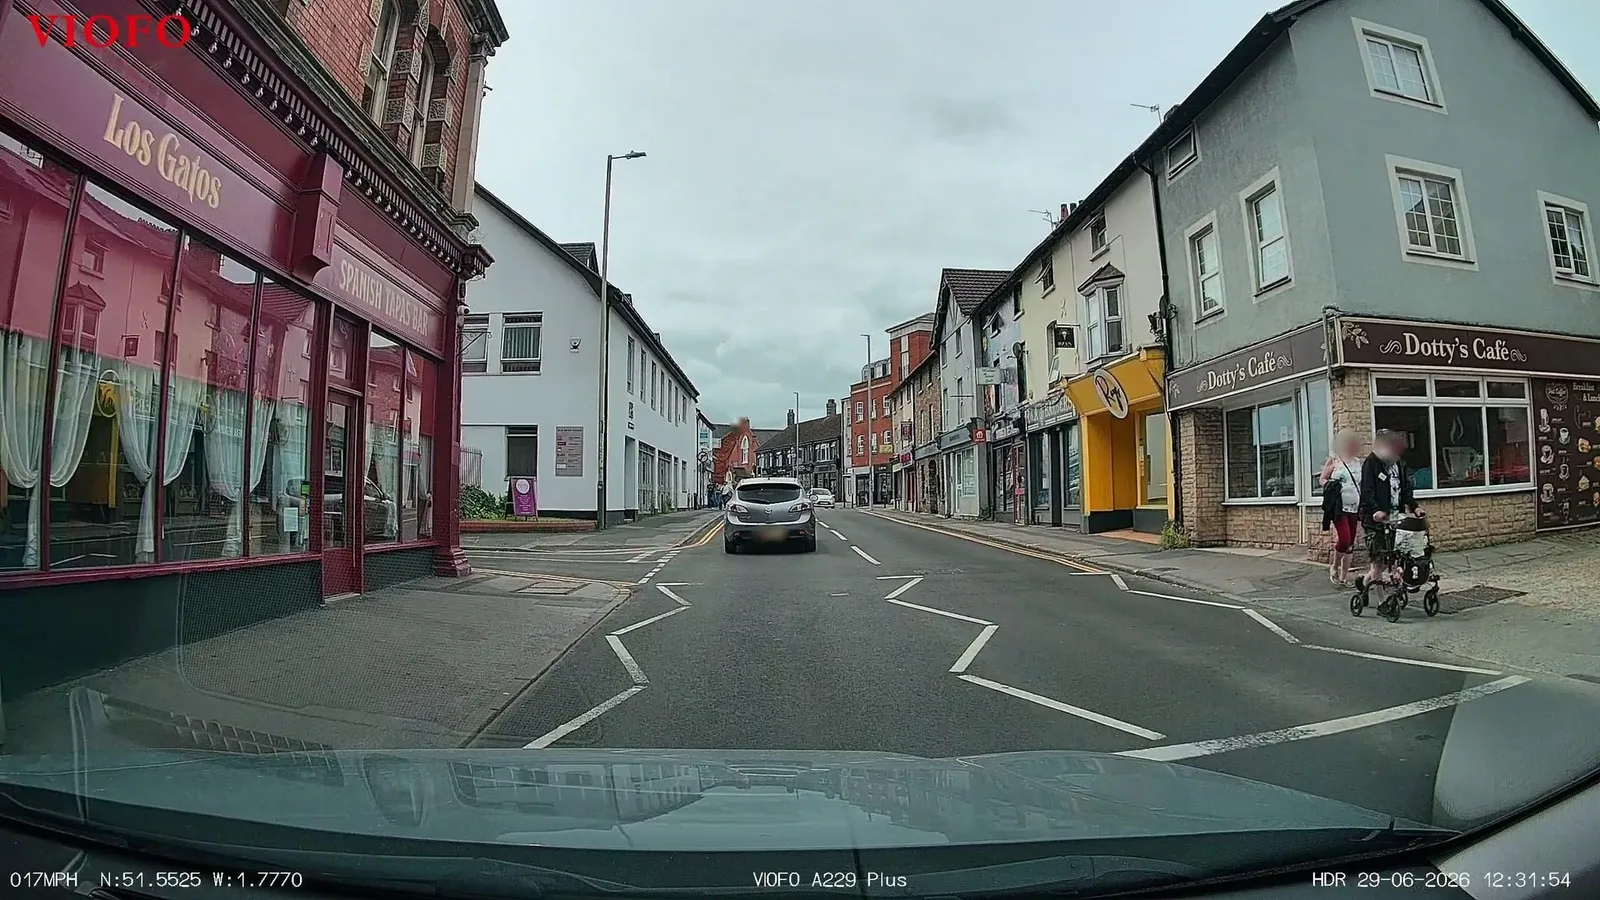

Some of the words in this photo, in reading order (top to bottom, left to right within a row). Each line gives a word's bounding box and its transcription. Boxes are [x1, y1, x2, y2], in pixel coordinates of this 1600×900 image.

[103, 93, 152, 167] Los
[157, 133, 222, 210] Gatos
[339, 259, 383, 310] SPANISH
[384, 286, 412, 326] TAPAS
[412, 306, 429, 337] BAR
[1207, 361, 1246, 391] Dotty's
[1248, 351, 1277, 379] Café
[1402, 331, 1468, 364] Dotty's
[1472, 337, 1509, 362] Café
